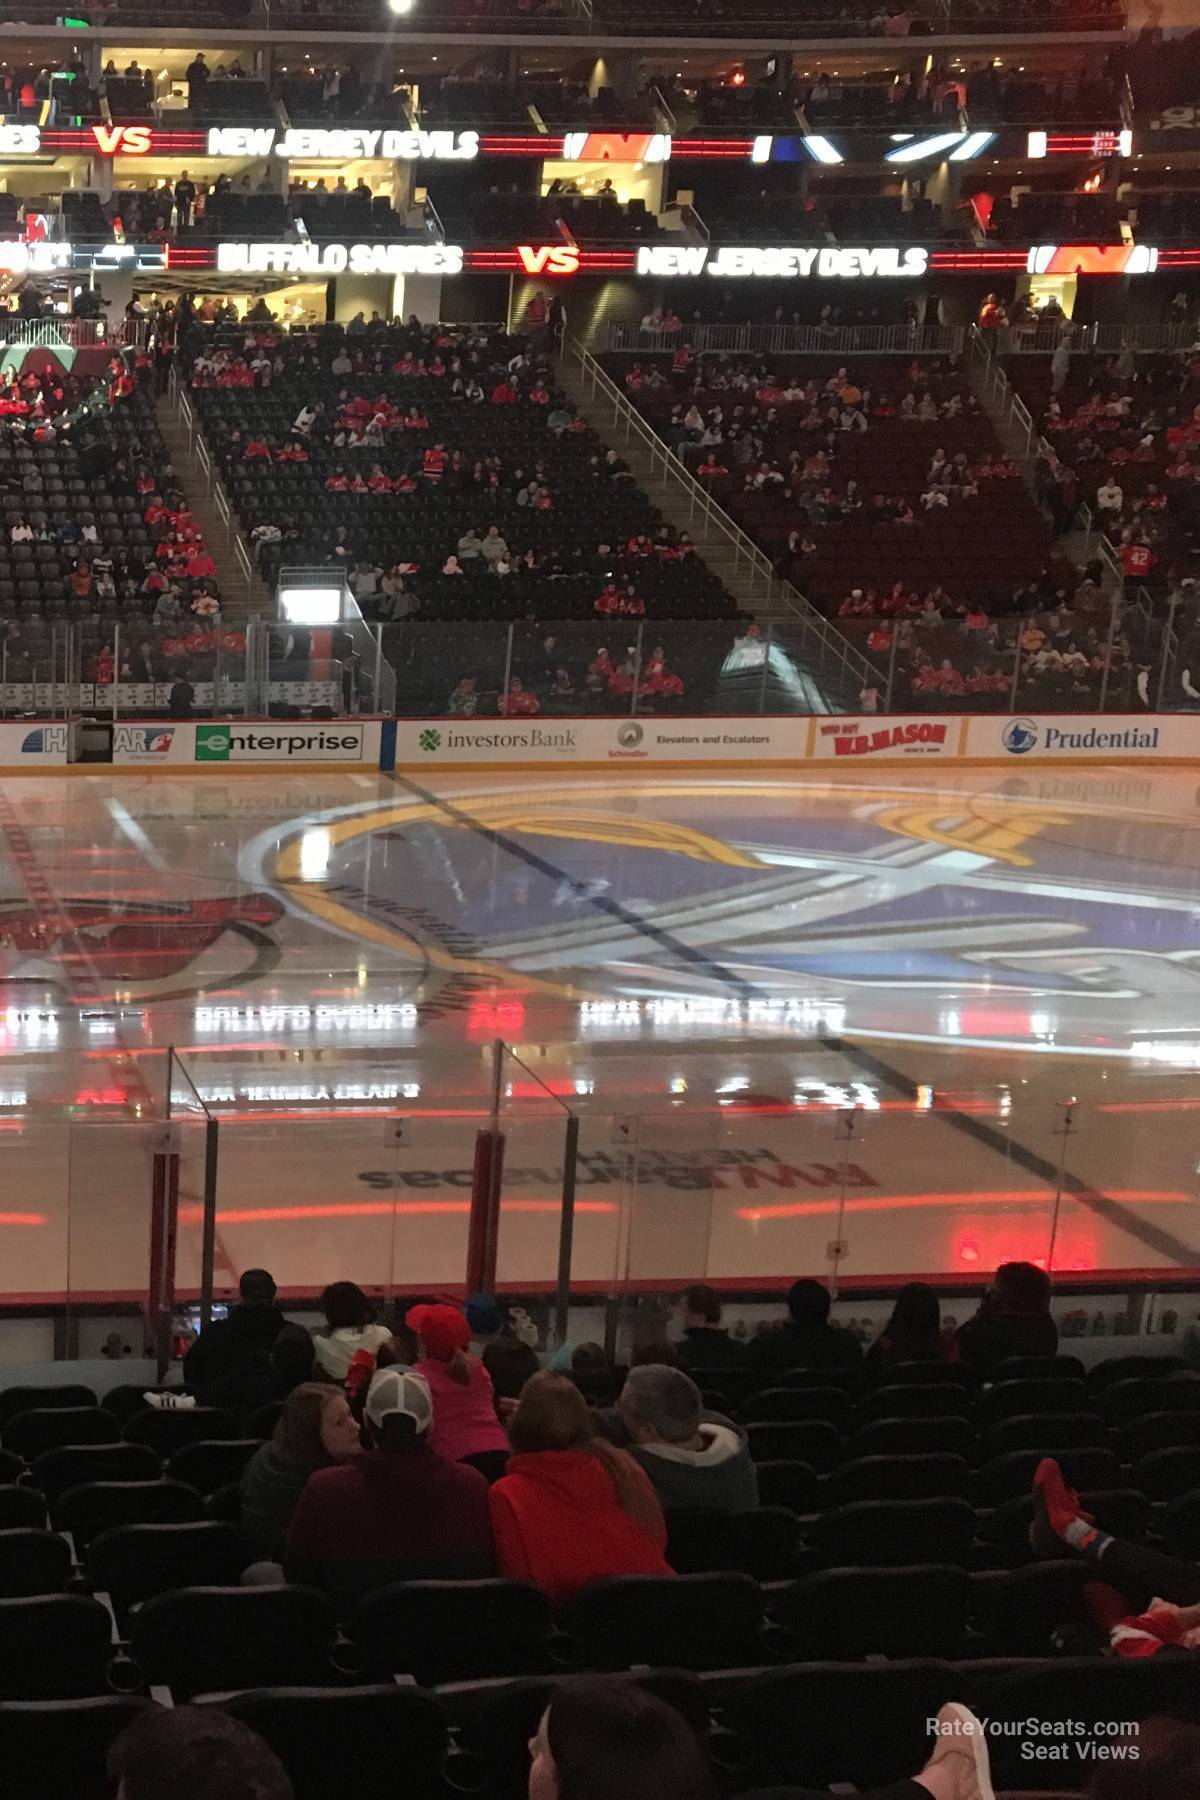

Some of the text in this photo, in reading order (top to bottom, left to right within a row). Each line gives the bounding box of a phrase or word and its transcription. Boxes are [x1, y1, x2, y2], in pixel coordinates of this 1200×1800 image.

[92, 126, 152, 154] VS
[208, 128, 479, 158] NEW JERSEY DEVILS
[218, 243, 347, 272] BUFFALO
[518, 246, 579, 273] VS
[637, 247, 928, 276] NEW JERSEY DEVILS
[206, 732, 359, 754] enterprise
[656, 735, 770, 744] Elevators and Escalators
[1044, 728, 1159, 748] Prudential
